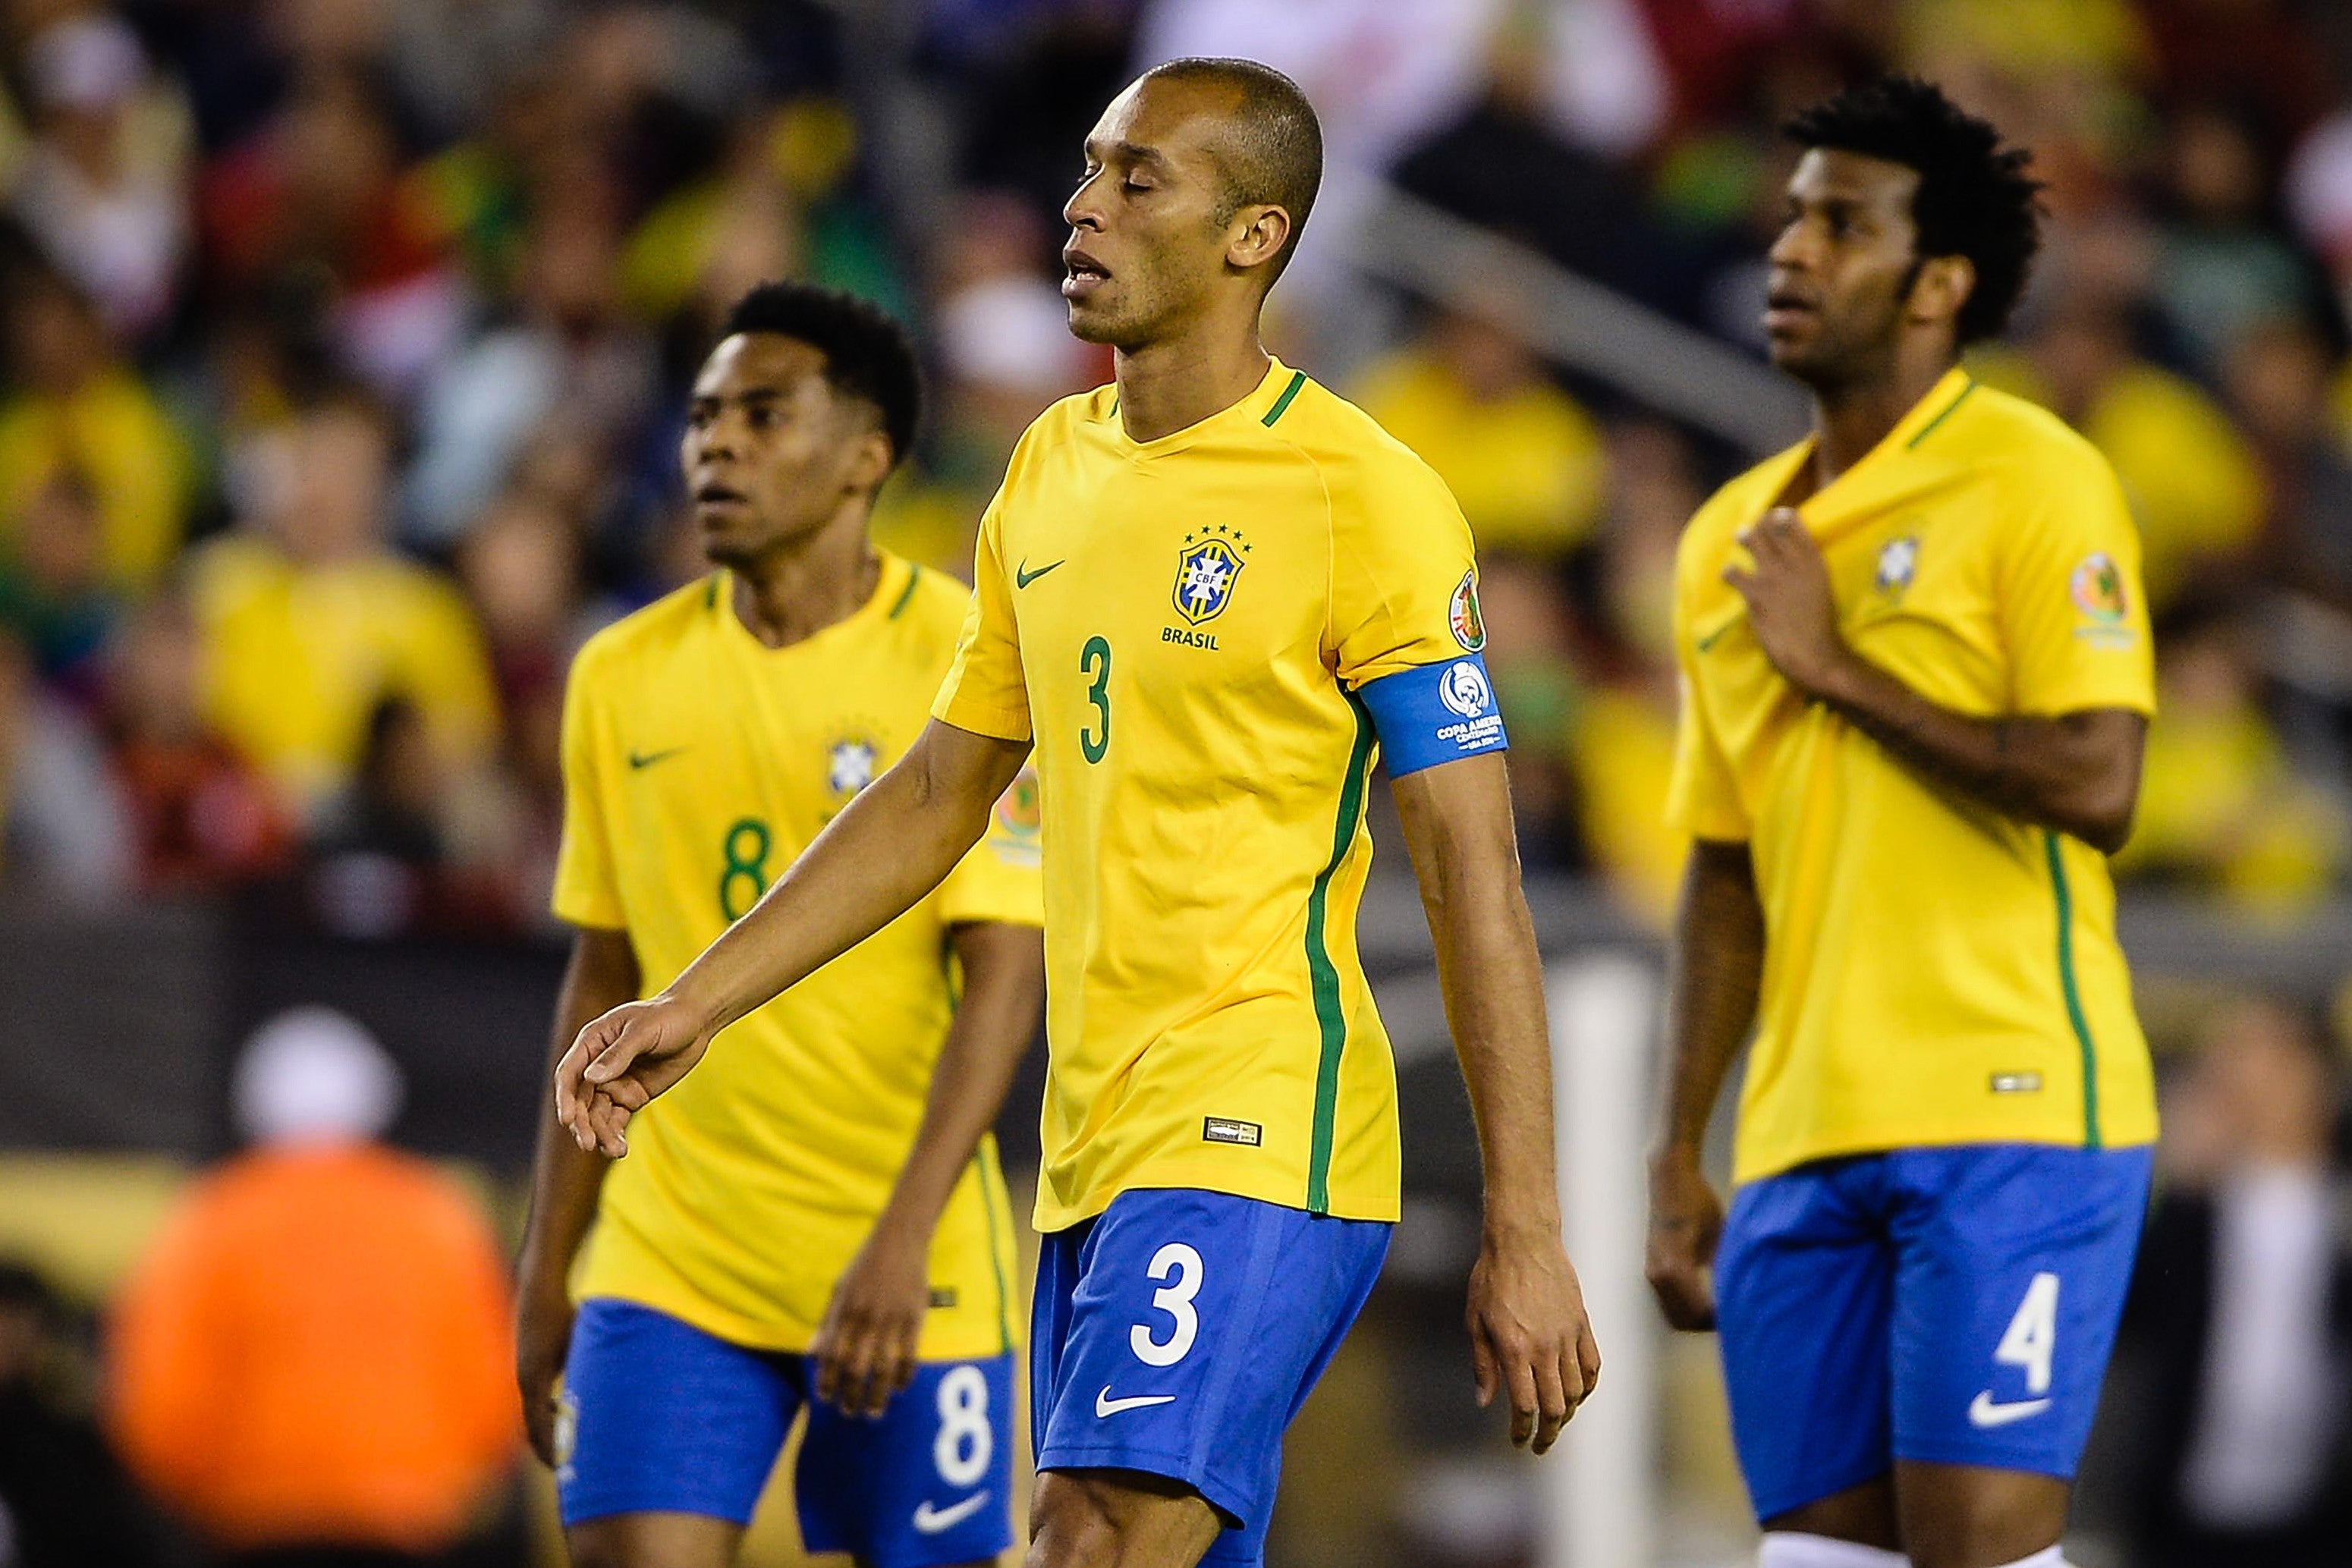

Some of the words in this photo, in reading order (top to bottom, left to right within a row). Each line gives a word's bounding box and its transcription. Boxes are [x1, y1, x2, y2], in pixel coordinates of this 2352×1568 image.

[1195, 573, 1217, 585] CBF
[1161, 627, 1219, 651] BRASIL
[1080, 636, 1112, 764] 3
[1437, 723, 1469, 740] COPA
[721, 818, 770, 922] 8
[1130, 1243, 1204, 1367] 3
[1994, 1272, 2059, 1394] 4
[934, 1365, 992, 1487] 8
